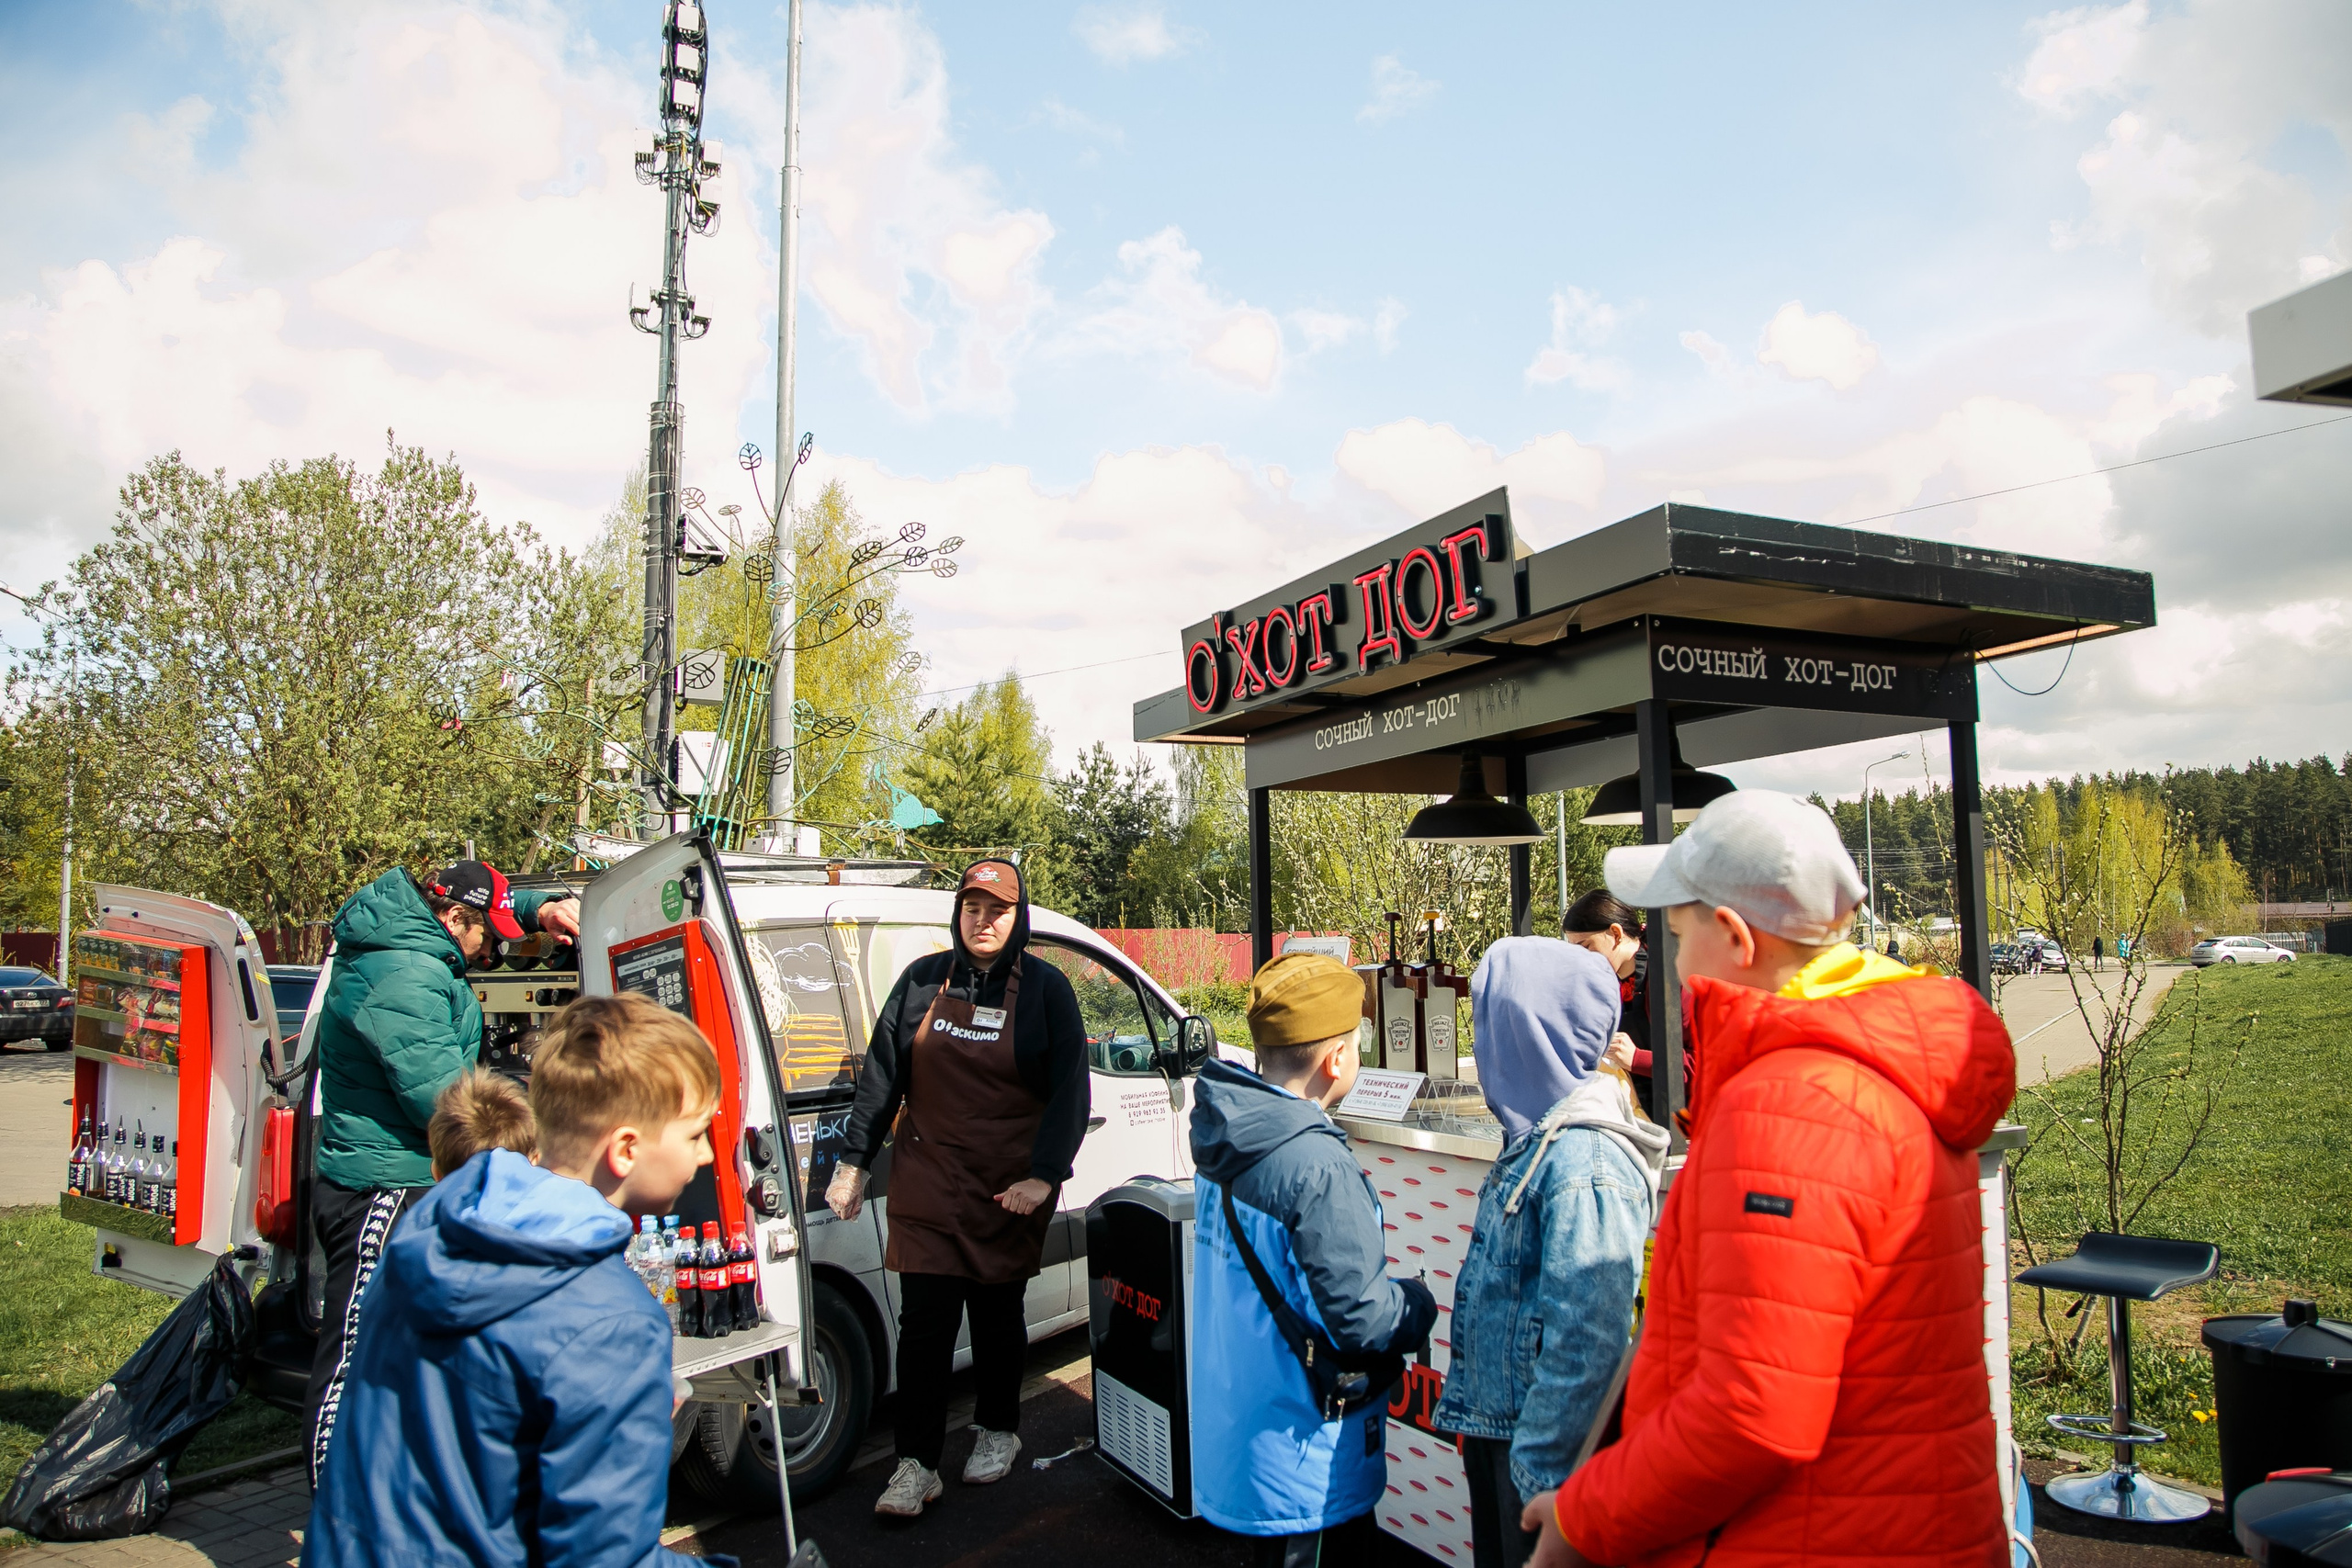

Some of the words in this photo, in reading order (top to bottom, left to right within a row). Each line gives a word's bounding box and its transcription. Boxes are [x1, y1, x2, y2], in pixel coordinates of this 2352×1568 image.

[1186, 592, 1334, 714] О'ХОТ
[1352, 525, 1492, 675] ДОГ
[1657, 644, 1768, 680] СОЧНЫЙ
[1784, 657, 1896, 692] ХОТ-ДОГ
[1315, 710, 1374, 750] СОЧНЫЙ
[1383, 693, 1461, 734] ХОТ-ДОГ
[469, 890, 488, 901] future
[477, 887, 490, 896] alfa
[463, 894, 486, 906] people
[1362, 1078, 1409, 1090] ТЕХНИЧЕСКИЙ
[1120, 1091, 1148, 1100] МОБИЛЬНАЯ
[1356, 1089, 1383, 1098] ПЕРЕРЫВ
[1136, 1291, 1161, 1322] ДОГ
